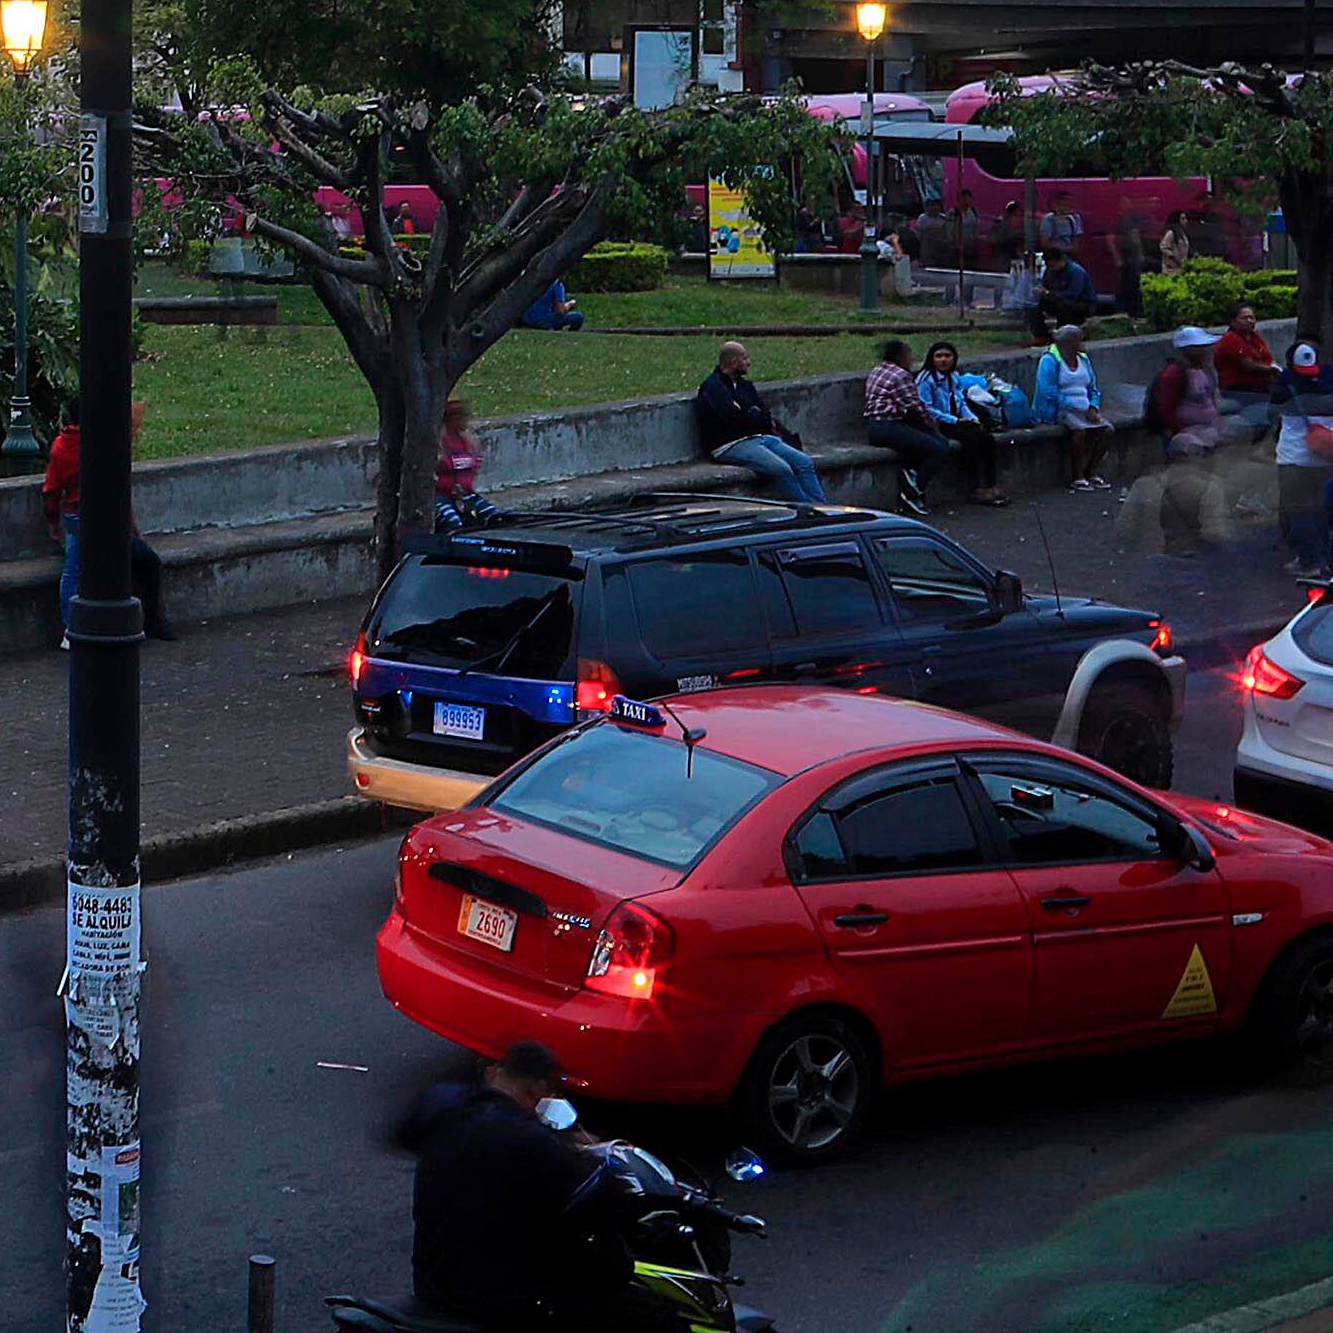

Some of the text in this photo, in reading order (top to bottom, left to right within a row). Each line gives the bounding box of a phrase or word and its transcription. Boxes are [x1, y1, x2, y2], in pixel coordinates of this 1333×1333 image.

[81, 143, 94, 204] 200
[623, 703, 646, 720] TAXI
[85, 915, 132, 930] ALQUILA
[476, 911, 506, 939] 2690
